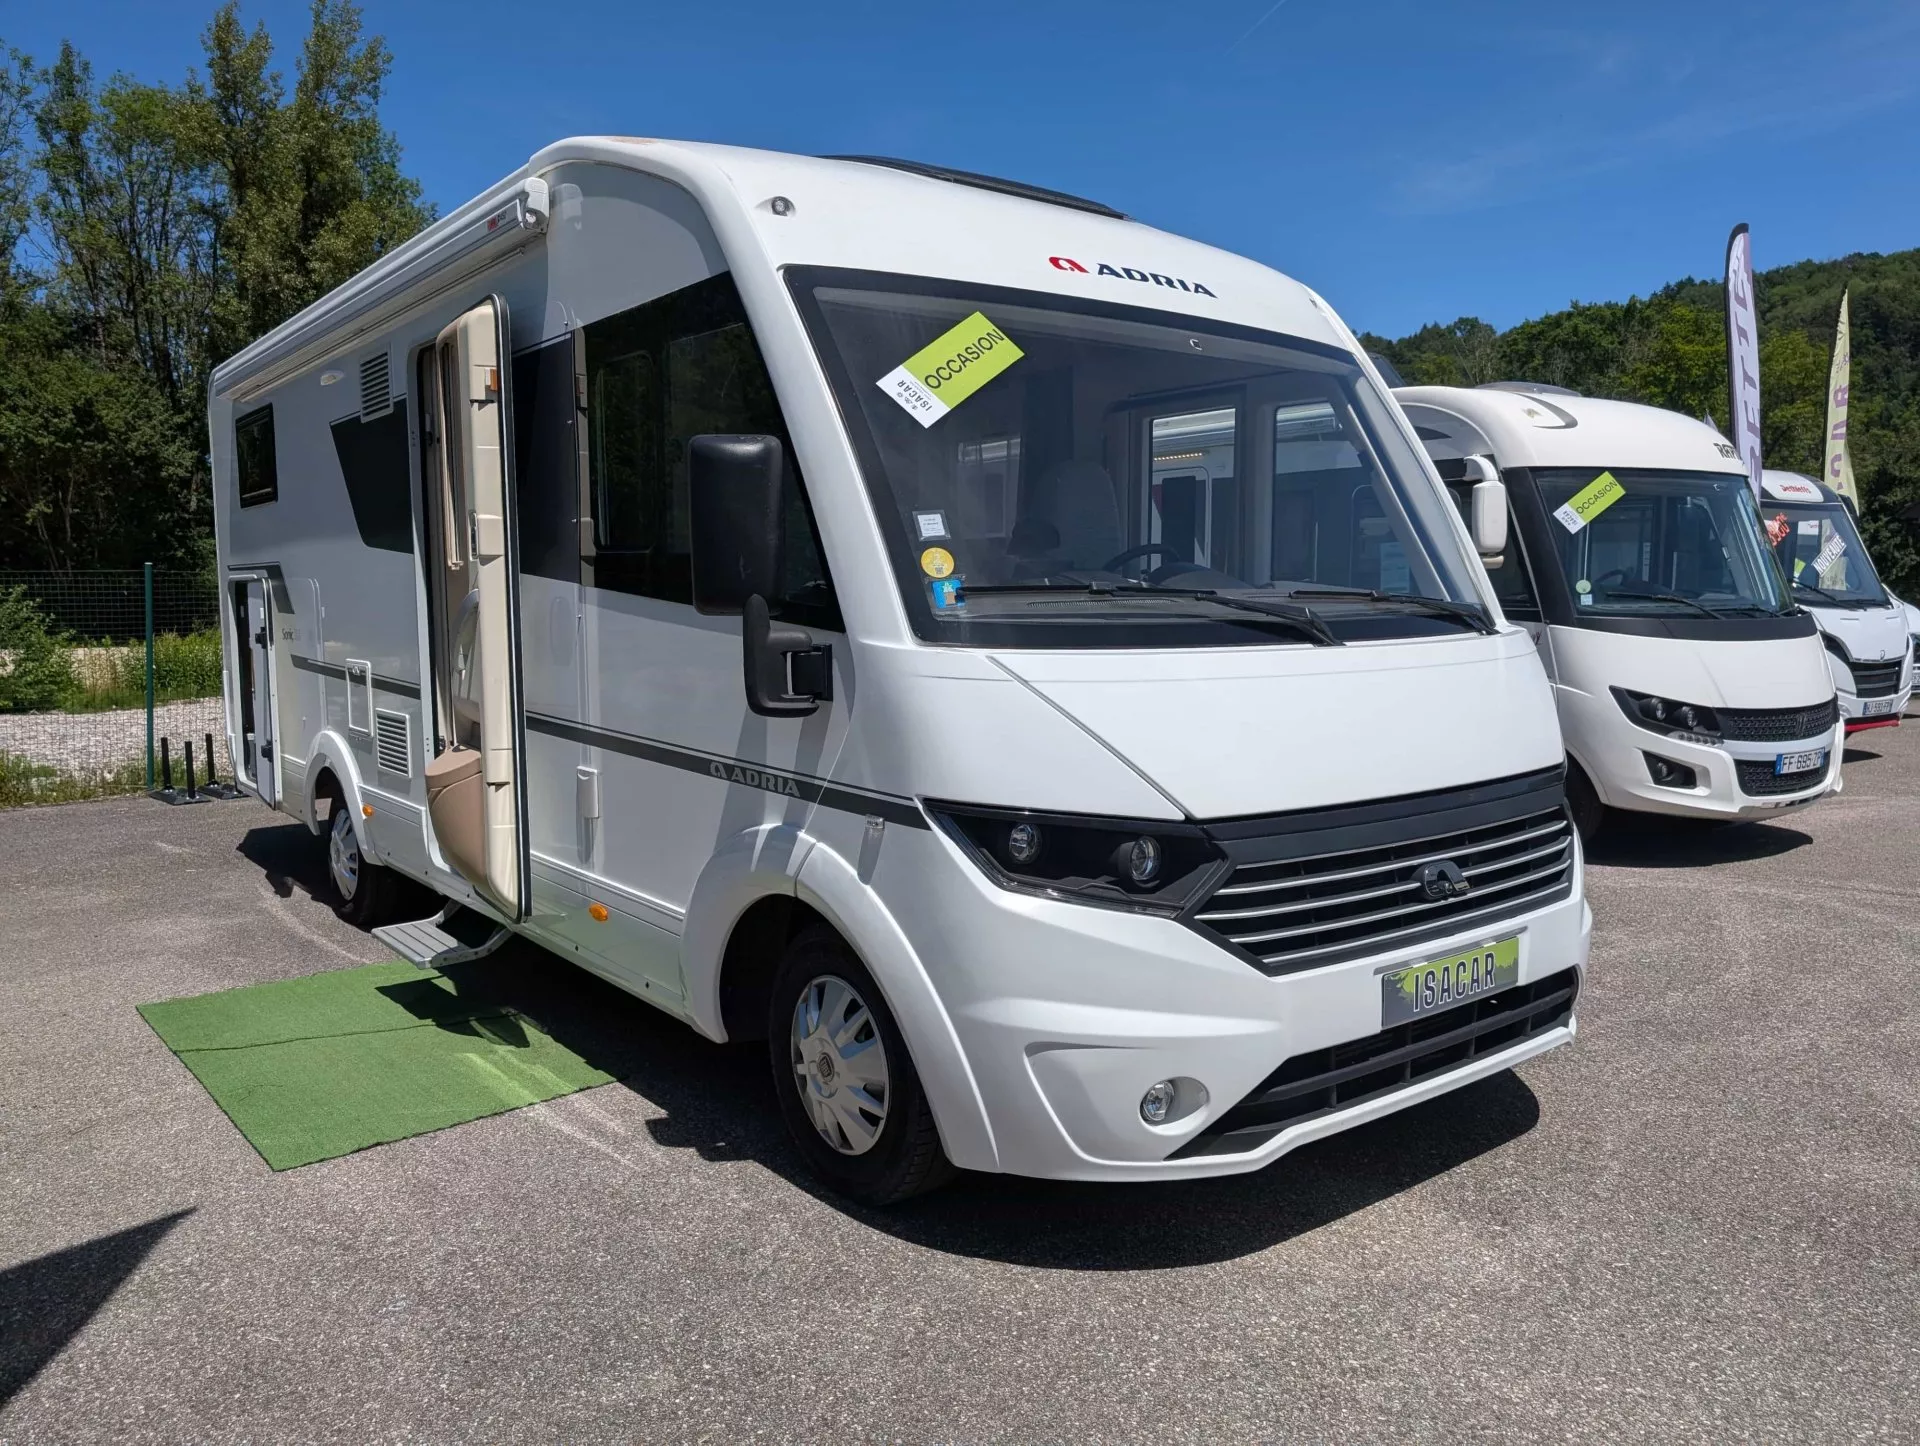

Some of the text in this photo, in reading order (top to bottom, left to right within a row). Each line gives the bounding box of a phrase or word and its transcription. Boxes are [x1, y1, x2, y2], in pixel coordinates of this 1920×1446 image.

[1097, 263, 1218, 298] ADRIA
[924, 328, 1005, 389] OCCASION
[897, 380, 933, 411] ISACAR
[1576, 480, 1618, 514] OCCASION
[730, 767, 801, 797] ADRIA
[1413, 952, 1496, 1012] ISACAR
